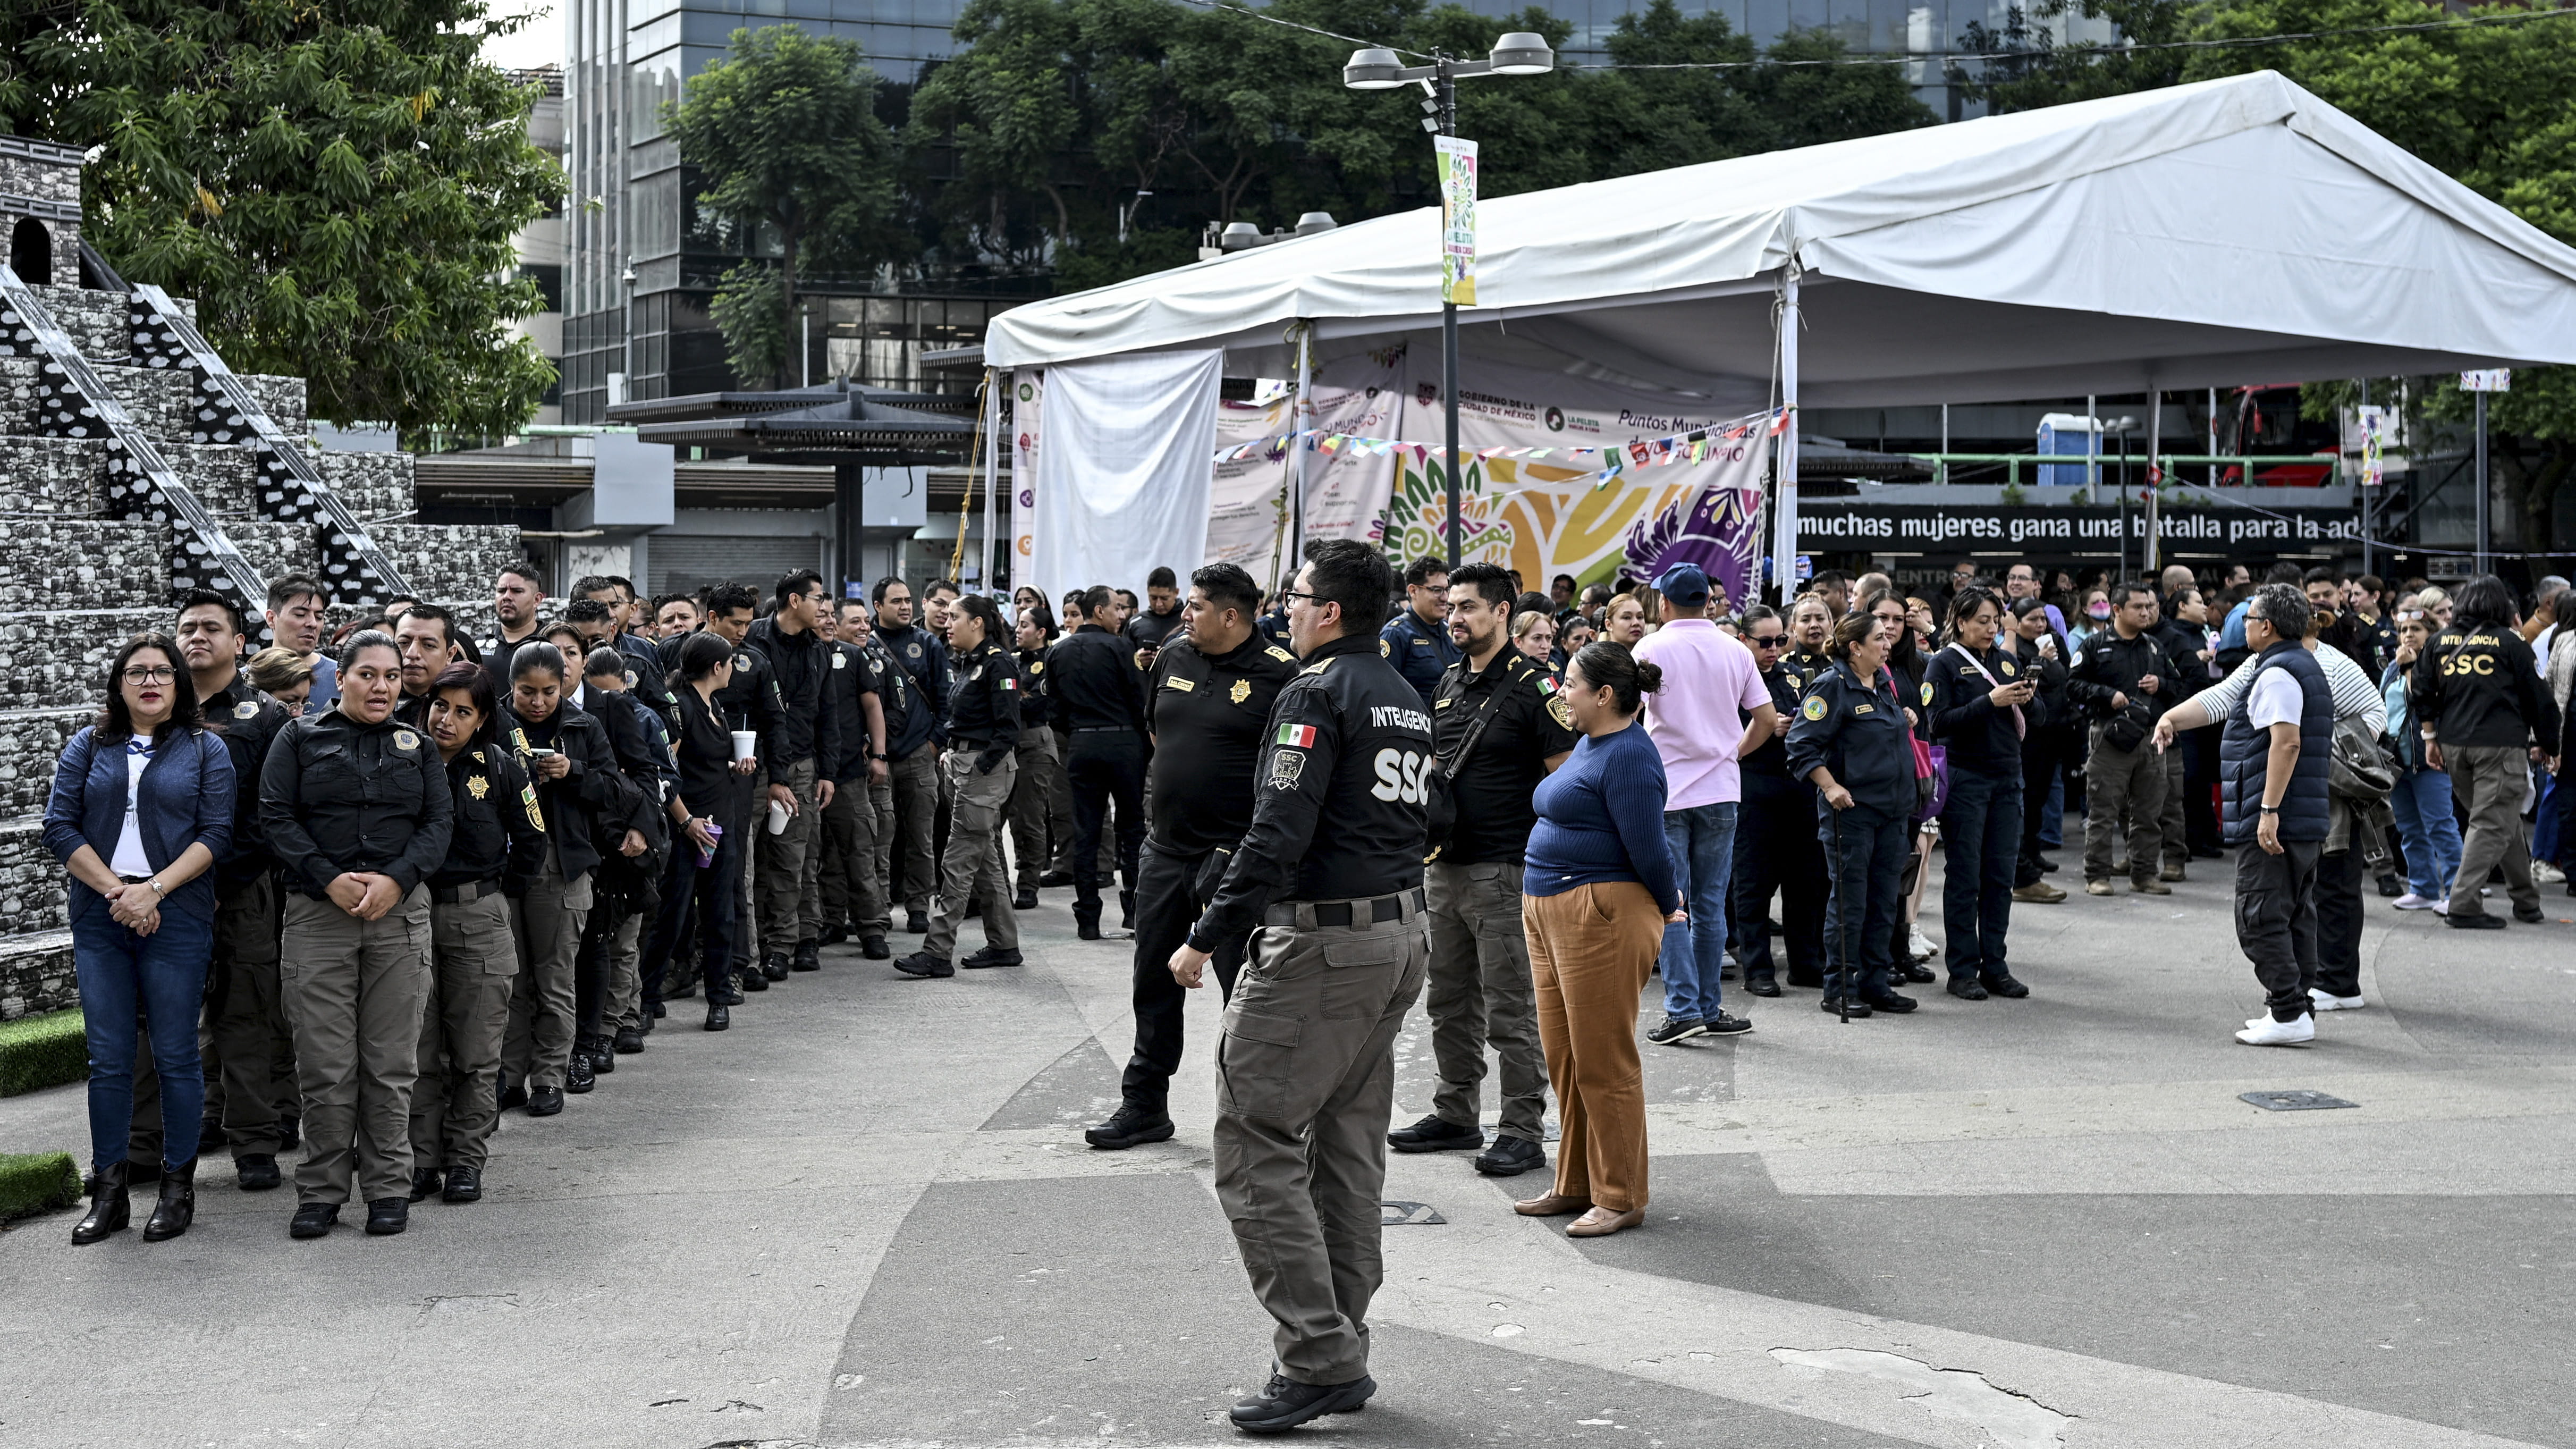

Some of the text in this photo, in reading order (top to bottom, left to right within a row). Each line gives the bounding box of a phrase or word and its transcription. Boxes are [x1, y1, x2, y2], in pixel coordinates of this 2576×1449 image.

[1459, 390, 1507, 407] GOBIERNO
[1510, 399, 1521, 409] DE
[1458, 401, 1536, 421] CIUDAD DE MÉXICO
[1619, 409, 1667, 431] Puntos
[1797, 512, 1893, 537] muchas
[1901, 511, 2005, 542] mujeres,
[2009, 517, 2071, 543] gana
[2079, 518, 2122, 538] una
[2230, 518, 2289, 544] para
[2296, 513, 2319, 540] la
[2440, 654, 2494, 676] SSC
[1370, 706, 1432, 737] INTELIGENCI
[1281, 754, 1297, 762] SSC
[1370, 748, 1432, 806] SSC
